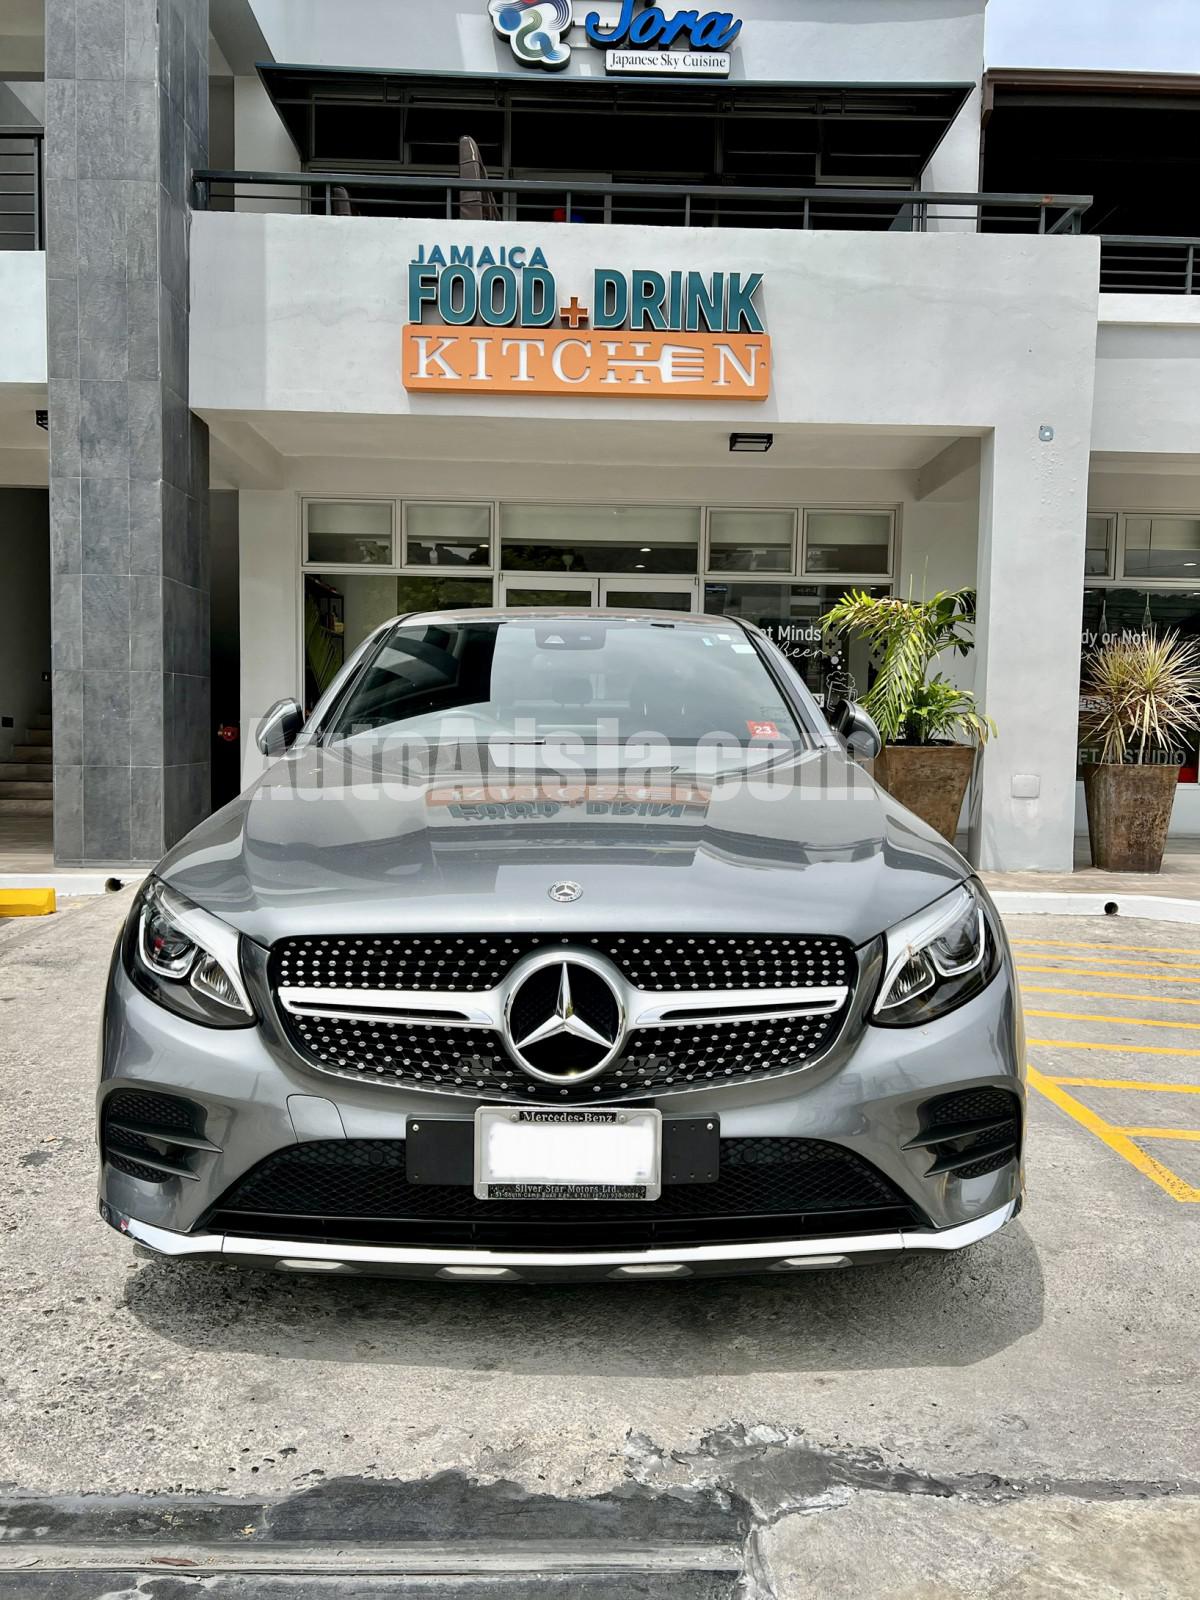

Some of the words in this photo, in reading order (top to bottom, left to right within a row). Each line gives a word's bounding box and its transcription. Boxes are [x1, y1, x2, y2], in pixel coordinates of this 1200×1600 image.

[585, 0, 743, 48] Jora
[609, 53, 659, 68] Japanese
[660, 53, 680, 69] Sky
[682, 54, 726, 67] Cuisine
[410, 244, 548, 268] JAMAICA
[408, 263, 557, 327] FOOD
[592, 268, 765, 333] DRINK
[409, 335, 763, 387] KITCHEN
[777, 625, 822, 641] Minds
[1102, 631, 1118, 645] or
[1122, 629, 1148, 645] Not
[753, 726, 772, 735] 23
[522, 1111, 614, 1123] Mercedes-Benz
[515, 1184, 542, 1193] Silver
[545, 1184, 565, 1193] Star
[567, 1185, 599, 1193] Motors
[602, 1185, 620, 1193] Ltd.
